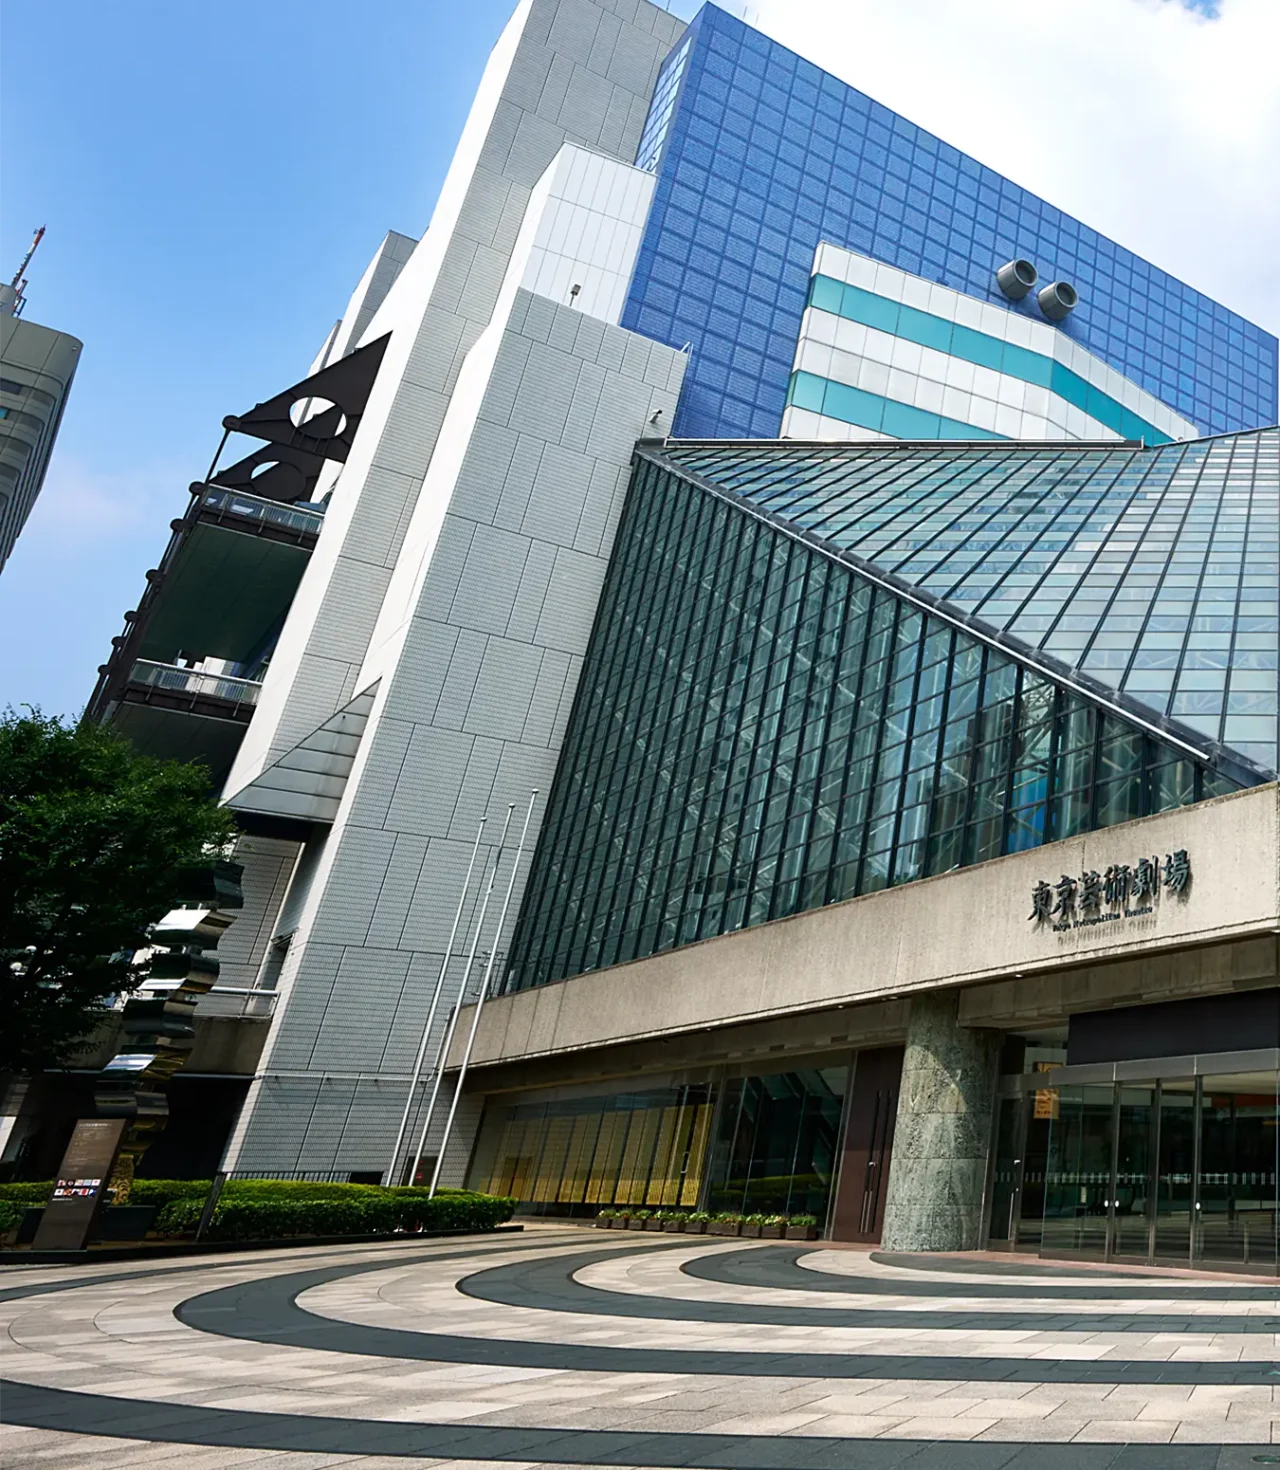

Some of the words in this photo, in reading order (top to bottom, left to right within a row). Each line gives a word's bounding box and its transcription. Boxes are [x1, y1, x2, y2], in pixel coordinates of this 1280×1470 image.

[1027, 849, 1190, 922] 東京芸術劇場
